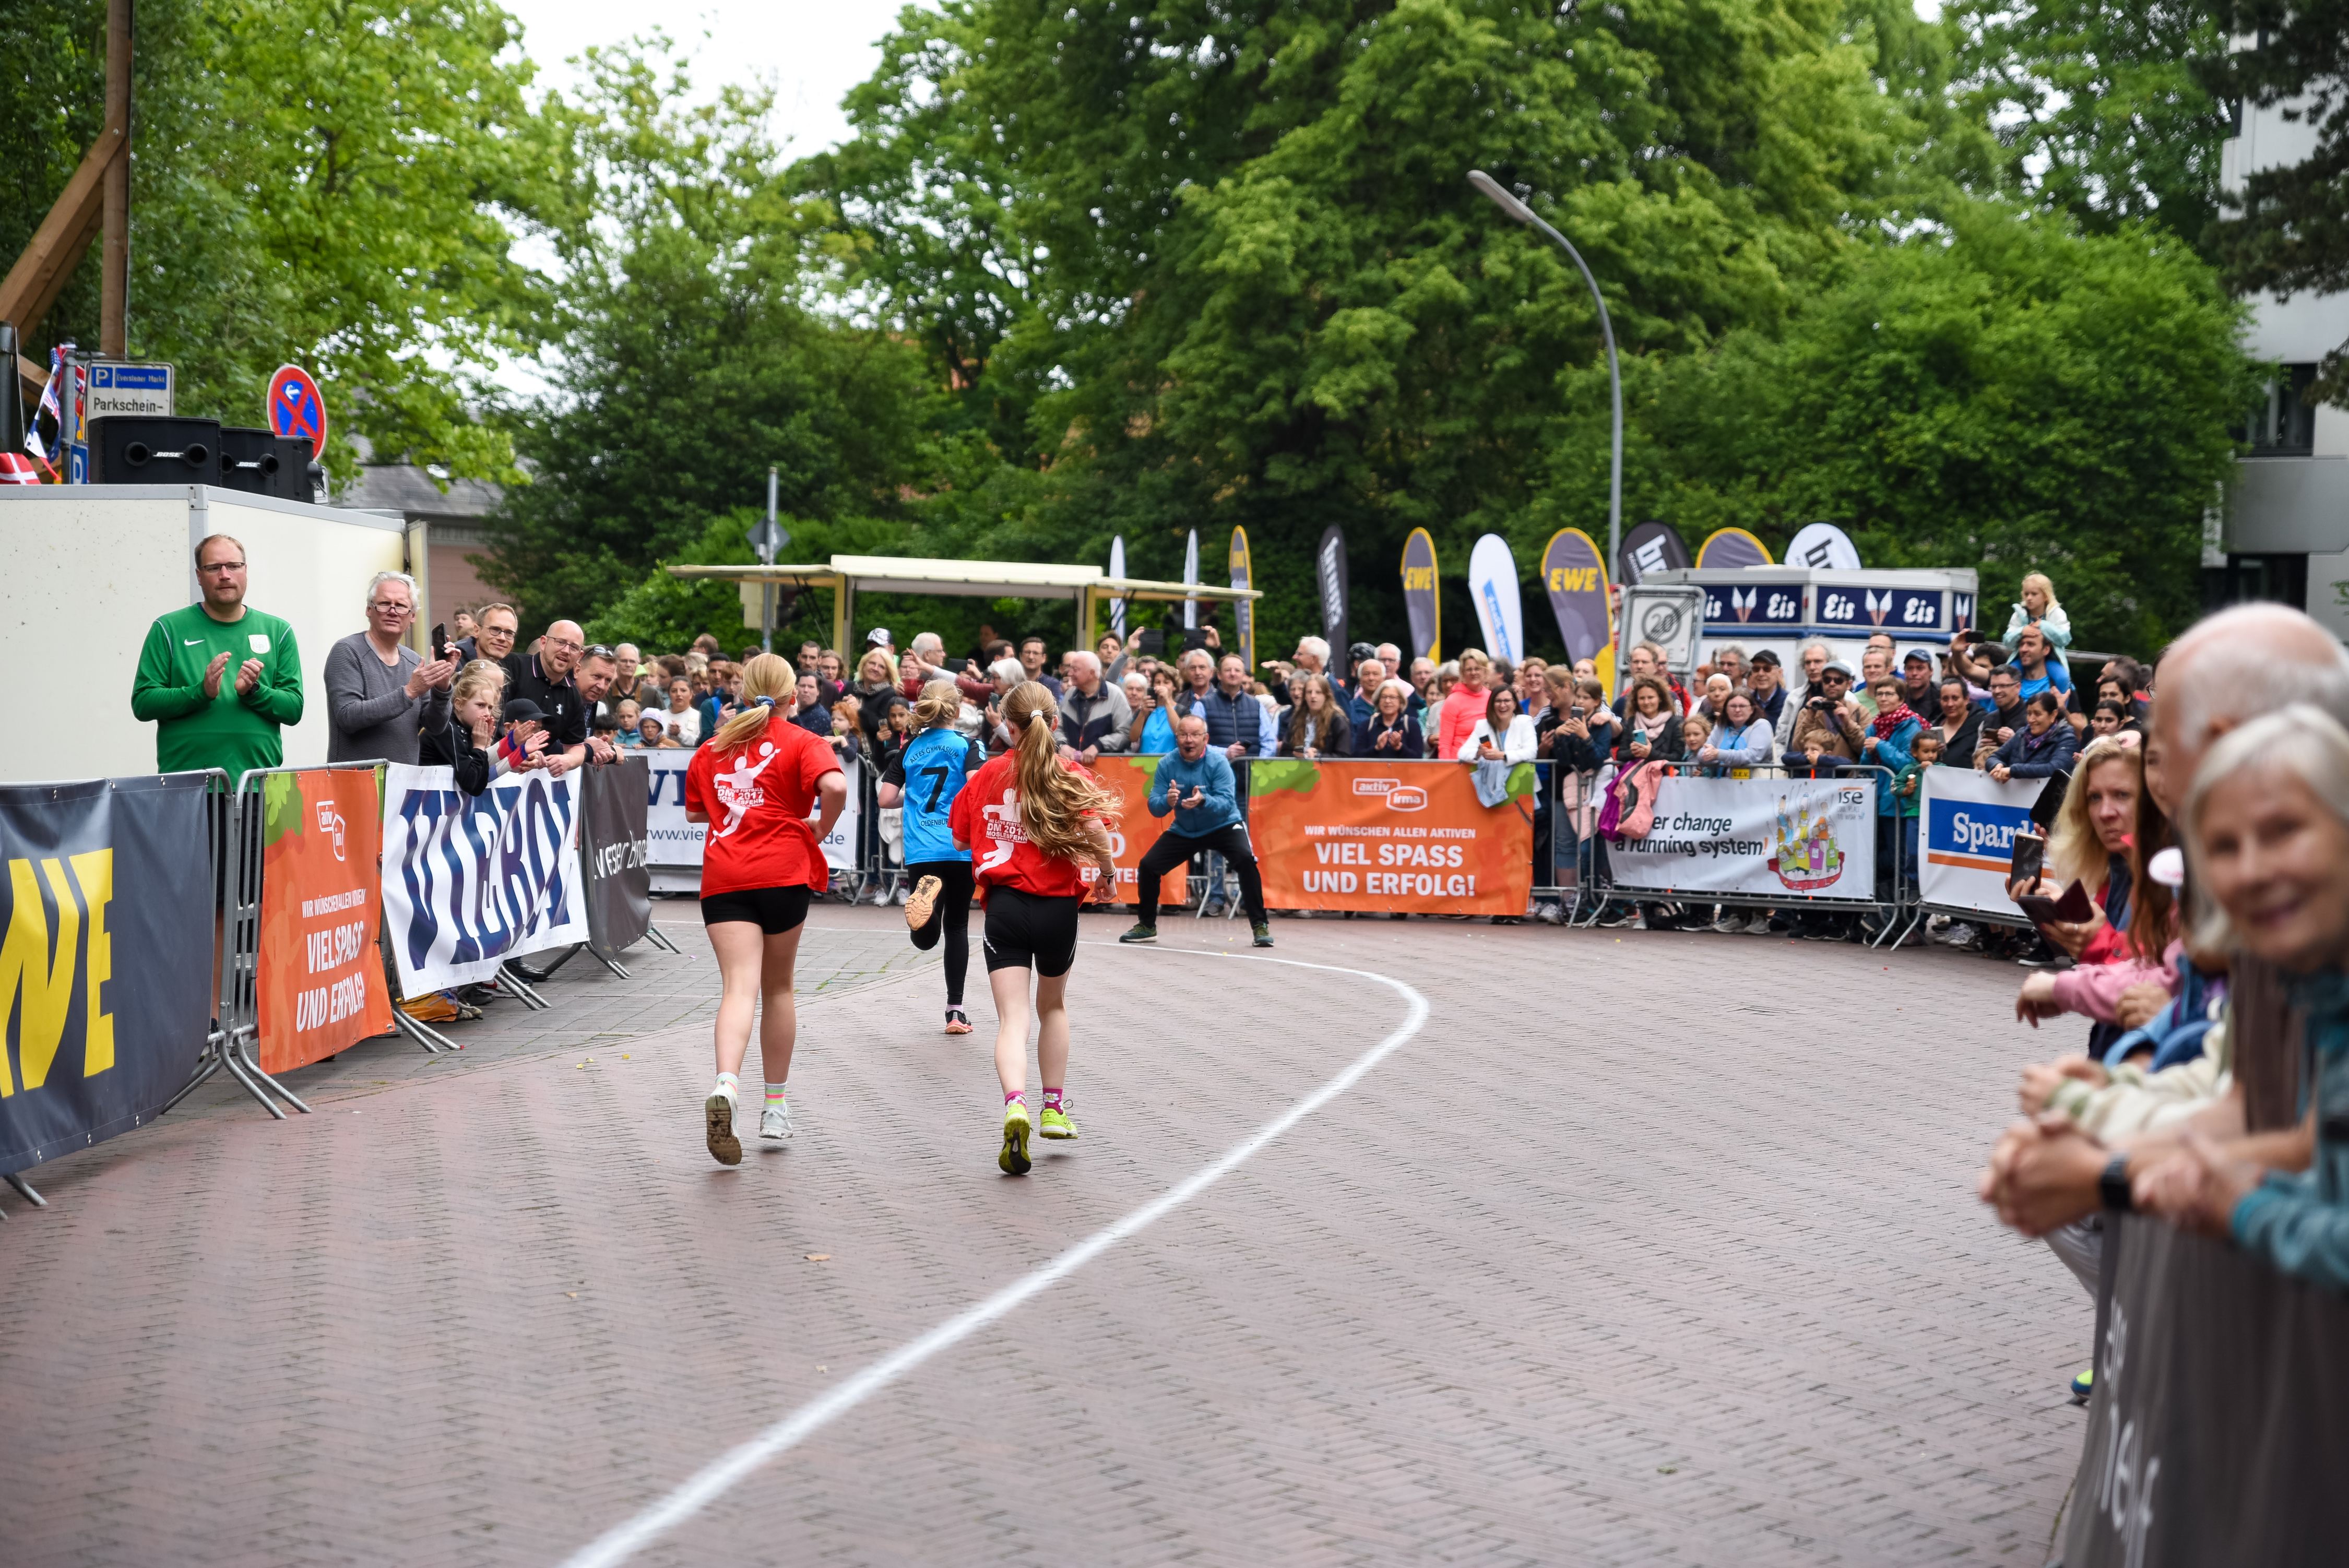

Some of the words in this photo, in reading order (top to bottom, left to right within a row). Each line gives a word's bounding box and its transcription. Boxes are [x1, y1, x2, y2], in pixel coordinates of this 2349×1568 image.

[96, 369, 108, 385] P
[93, 397, 163, 412] Parkschein-
[1549, 567, 1598, 591] EWE
[1705, 595, 1723, 619] is
[1766, 593, 1796, 619] Eis
[1823, 593, 1855, 620] Eis
[1903, 598, 1935, 624] Eis
[910, 750, 925, 764] ALTES
[926, 745, 959, 759] GYMNASIUM
[717, 789, 734, 798] DM
[737, 791, 763, 800] 2017
[920, 766, 948, 813] 7
[1359, 782, 1390, 791] aktiv
[1394, 793, 1421, 804] irma
[920, 818, 948, 827] OLDENBUR
[987, 823, 1001, 831] DM
[1304, 826, 1325, 836] WIR
[1327, 825, 1391, 837] WÜNSCHEN
[1393, 827, 1428, 838] ALLEN
[1430, 829, 1476, 839] AKTIVEN
[1673, 812, 1732, 836] change
[986, 830, 1028, 841] MOSLESFEHN
[1630, 835, 1696, 857] running
[1699, 837, 1769, 859] system!
[1314, 842, 1372, 865] VIEL
[1378, 844, 1464, 868] SPASS
[1303, 870, 1358, 893] UND
[1366, 872, 1476, 897] ERFOLG!
[302, 900, 314, 918] WIR
[307, 928, 336, 975] VIEL
[334, 920, 364, 967] SPASS
[296, 987, 328, 1033] UND
[329, 971, 365, 1024] ERFOLG!
